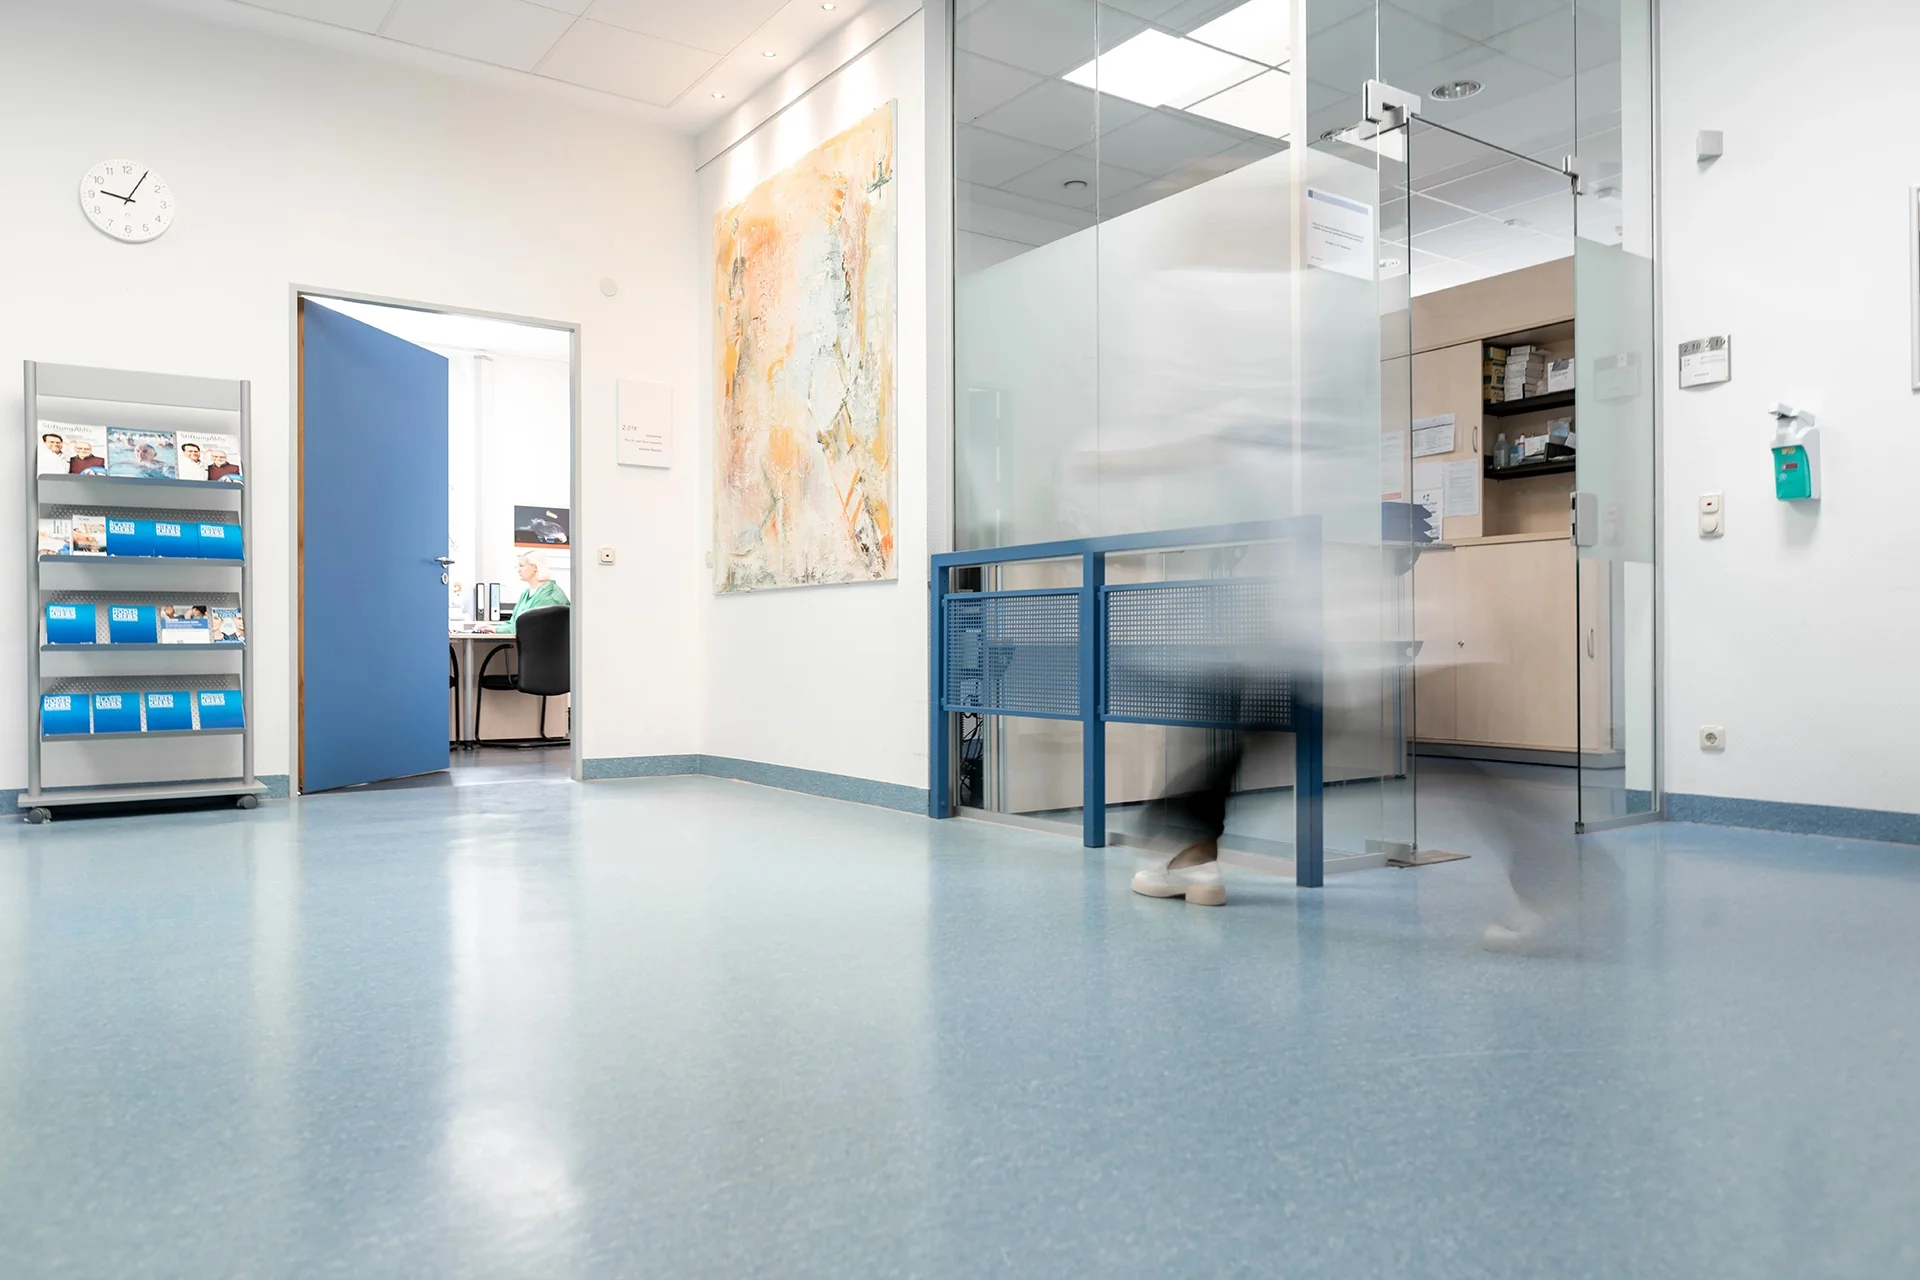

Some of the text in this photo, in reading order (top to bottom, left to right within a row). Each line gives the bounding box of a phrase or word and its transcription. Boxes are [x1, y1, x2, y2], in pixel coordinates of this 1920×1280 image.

[106, 167, 114, 176] 11
[122, 165, 133, 175] 12
[94, 176, 105, 185] 10
[88, 189, 95, 199] 9
[154, 184, 161, 194] 2
[93, 205, 101, 215] 8
[160, 200, 167, 210] 3
[107, 218, 114, 227] 7
[154, 215, 162, 223] 4
[124, 224, 132, 234] 6
[142, 223, 150, 233] 5
